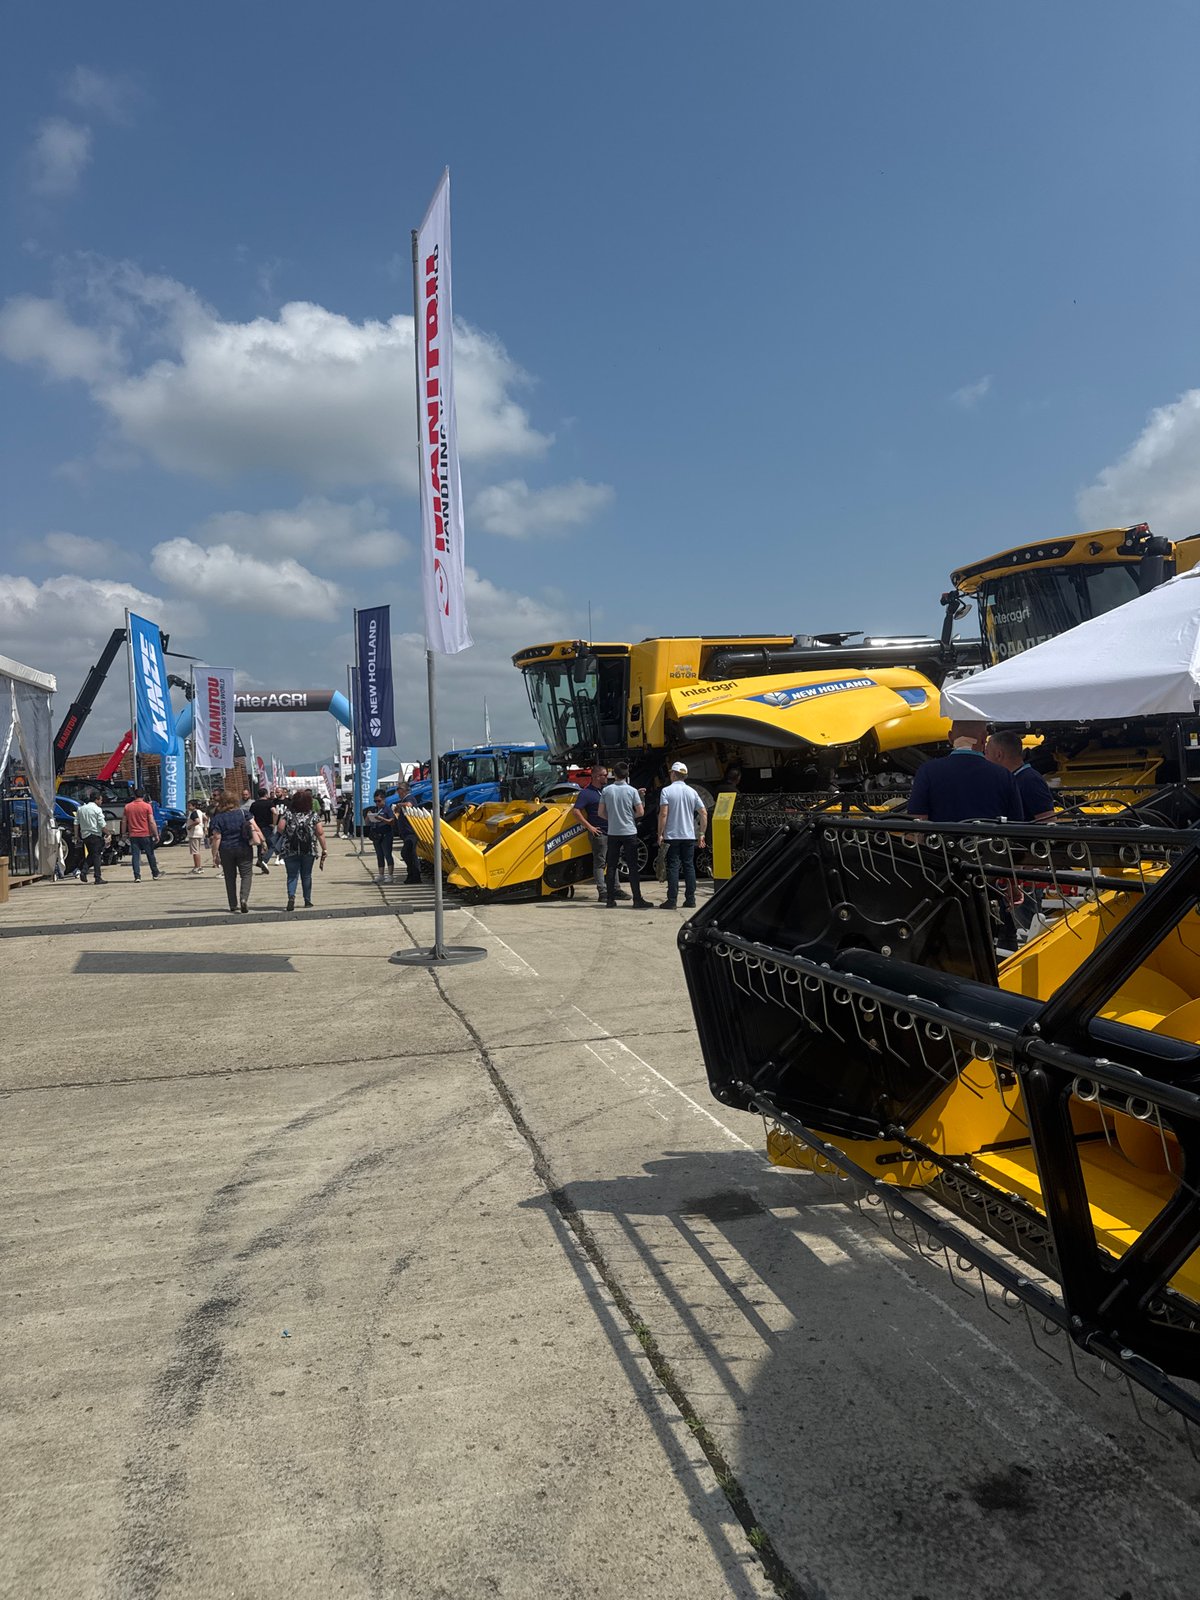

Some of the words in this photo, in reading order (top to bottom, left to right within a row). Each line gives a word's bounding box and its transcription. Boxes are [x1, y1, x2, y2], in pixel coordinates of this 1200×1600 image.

[368, 620, 377, 682] HOLLAND
[140, 632, 169, 743] KINZE
[370, 685, 379, 714] NEW
[680, 681, 738, 697] Interagri
[792, 688, 817, 700] NEW
[817, 680, 872, 694] HOLLAND
[207, 676, 222, 745] MANITOU
[546, 836, 562, 850] NEW
